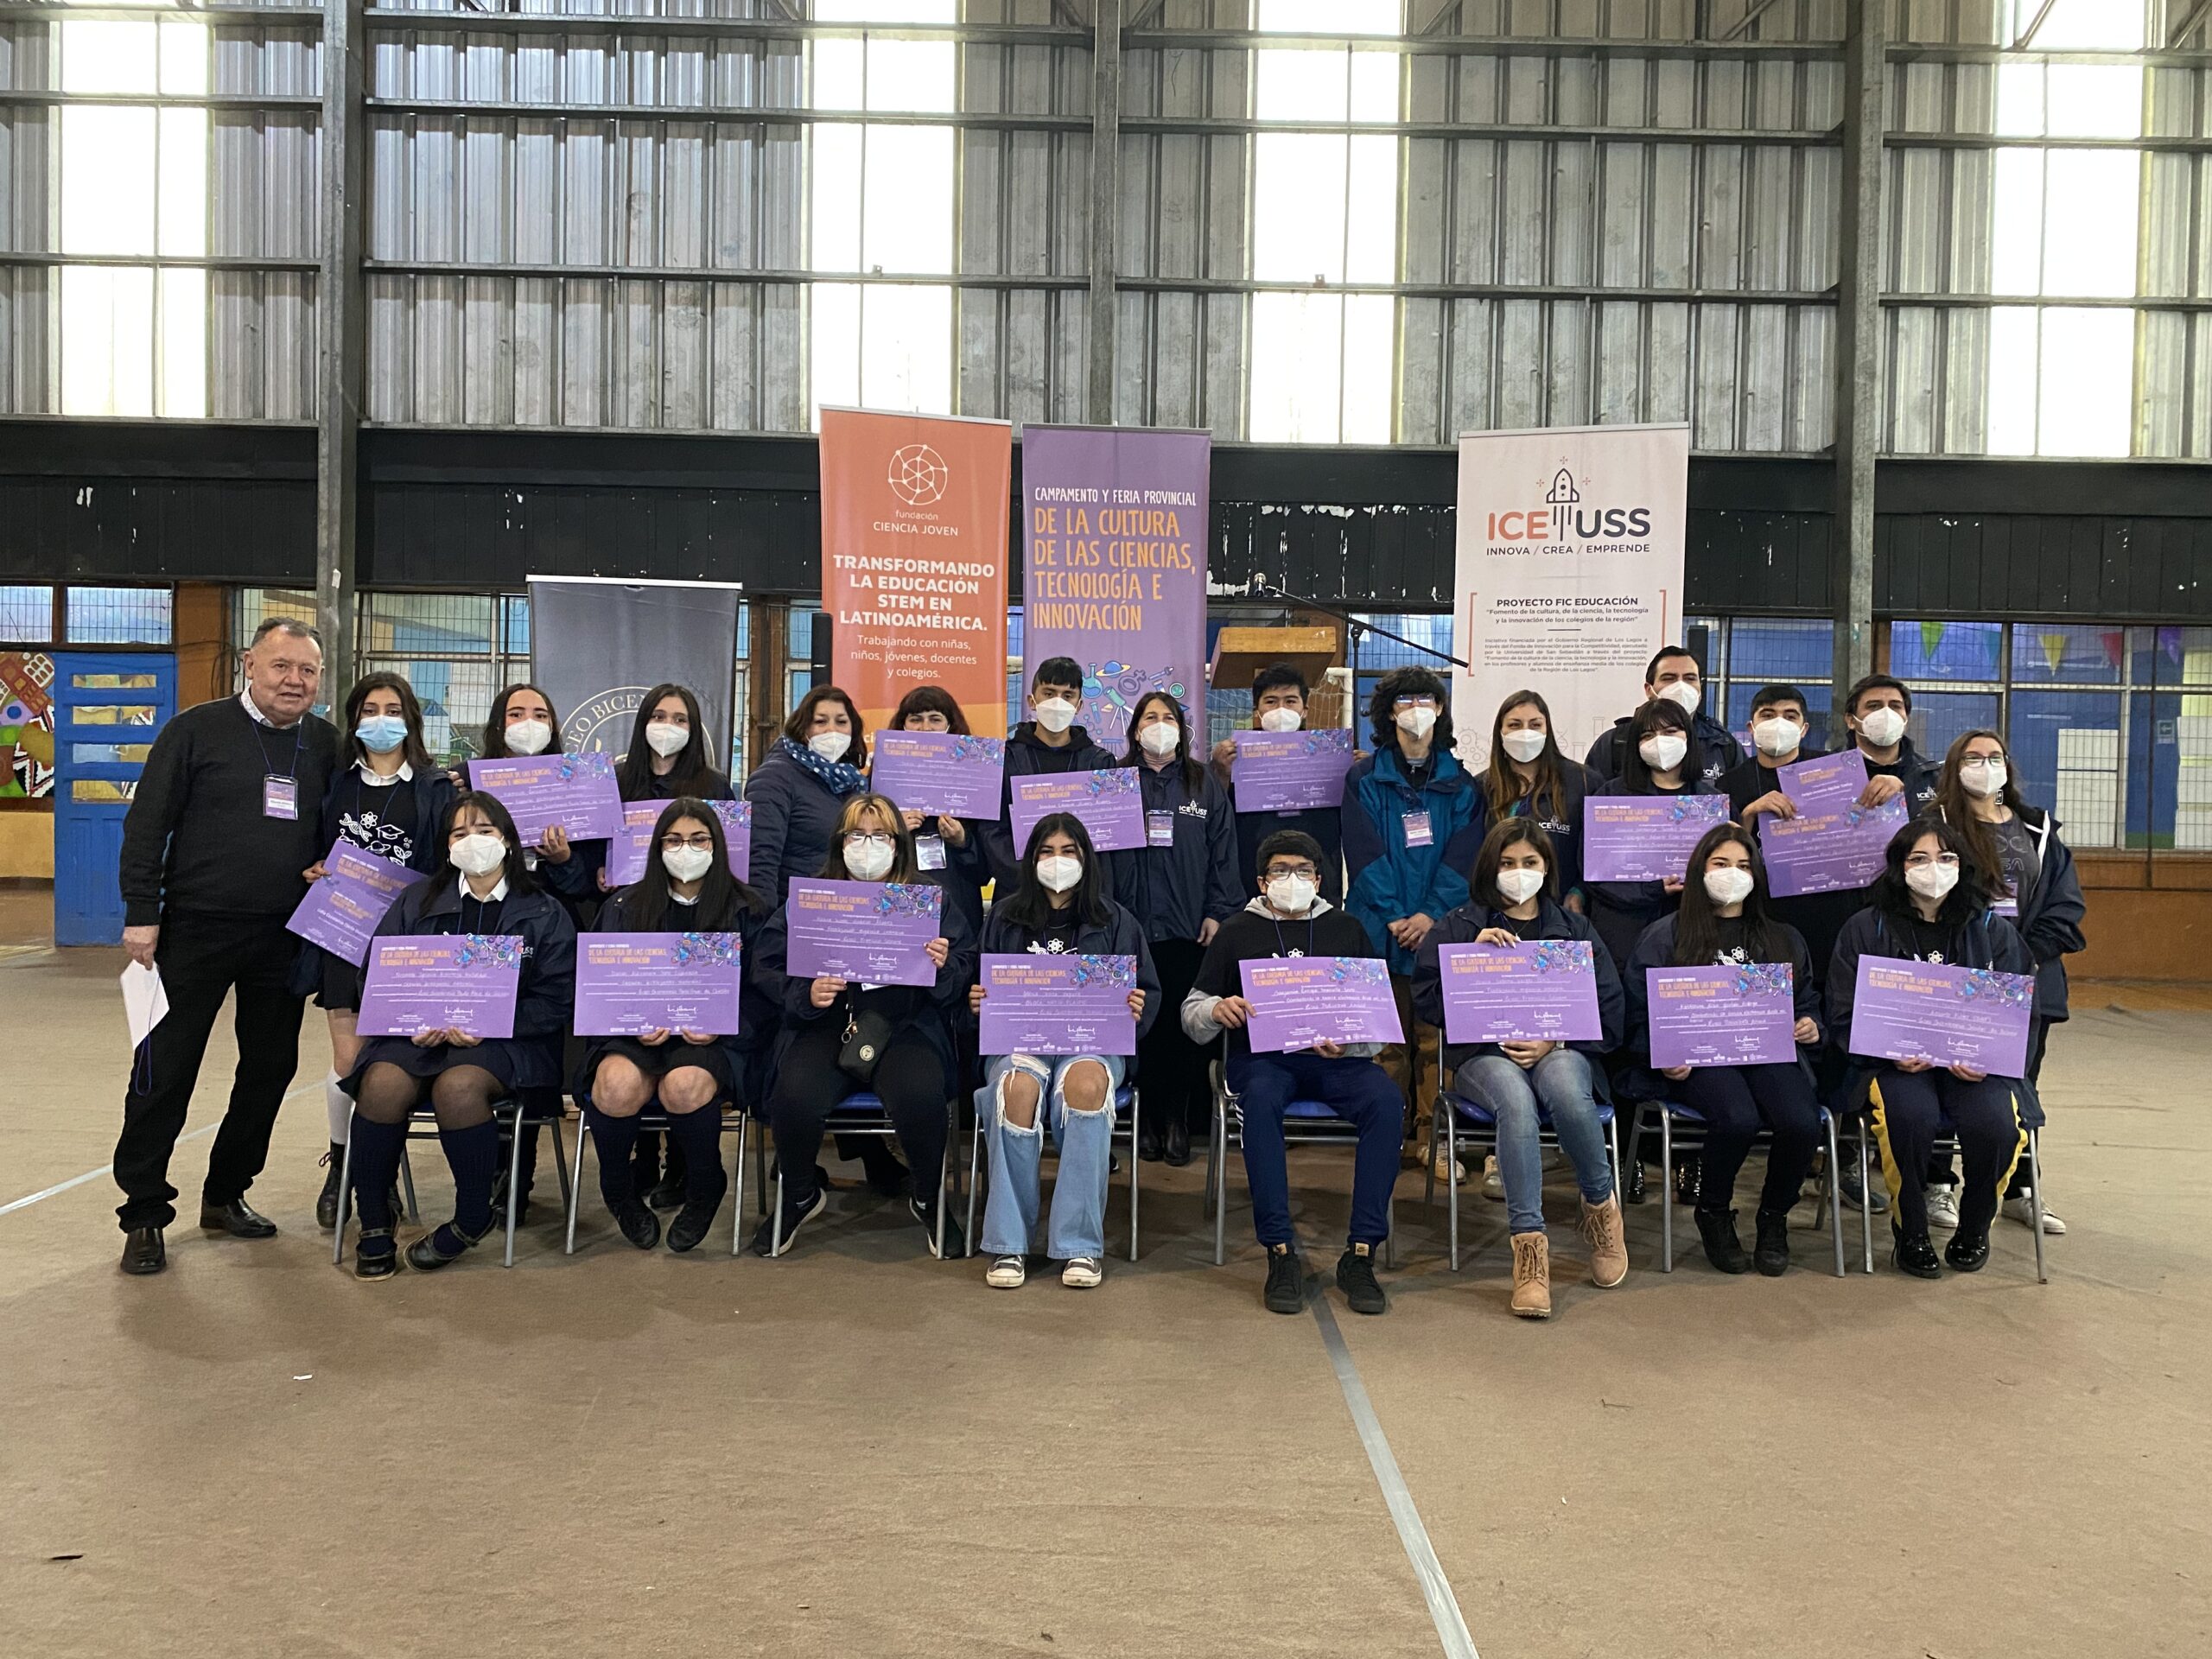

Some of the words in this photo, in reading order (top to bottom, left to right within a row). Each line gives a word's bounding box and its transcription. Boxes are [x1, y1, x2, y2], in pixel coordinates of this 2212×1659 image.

[1035, 487, 1097, 502] CAMPAMENTO
[1103, 489, 1109, 503] Y
[1113, 490, 1140, 504] FERIA
[1145, 491, 1196, 505] PROVINCIAL
[895, 510, 938, 520] fundación
[1035, 508, 1057, 534] DE
[1066, 508, 1090, 535] LA
[1099, 510, 1179, 537] CULTURA
[874, 522, 918, 533] CIENCIA
[922, 525, 957, 536] JOVEN
[1488, 511, 1548, 541] ICE
[1575, 508, 1651, 538] USS
[1035, 539, 1057, 566] DE
[1066, 540, 1100, 566] LAS
[1109, 542, 1195, 575] CIENCIAS,
[1487, 547, 1529, 556] INNOVA
[1586, 544, 1649, 553] EMPRENDE
[833, 555, 995, 577] TRANSFORMANDO
[850, 574, 873, 588] LA
[879, 576, 978, 594] EDUCACIÓN
[1034, 569, 1142, 599] TECNOLOGÍA
[1153, 574, 1162, 600] E
[878, 594, 924, 609] STEM
[930, 597, 951, 611] EN
[1575, 596, 1637, 606] EDUCACIÓN
[840, 610, 987, 630] LATINOAMÉRICA.
[1034, 603, 1141, 631] INNOVACIÓN
[857, 635, 917, 648] Trabajando
[941, 639, 970, 650] niñas,
[851, 650, 881, 661] niños,
[885, 651, 927, 664] jóvenes,
[931, 653, 976, 664] docentes
[887, 669, 893, 678] y
[897, 667, 940, 679] colegios.
[1196, 807, 1207, 816] USS
